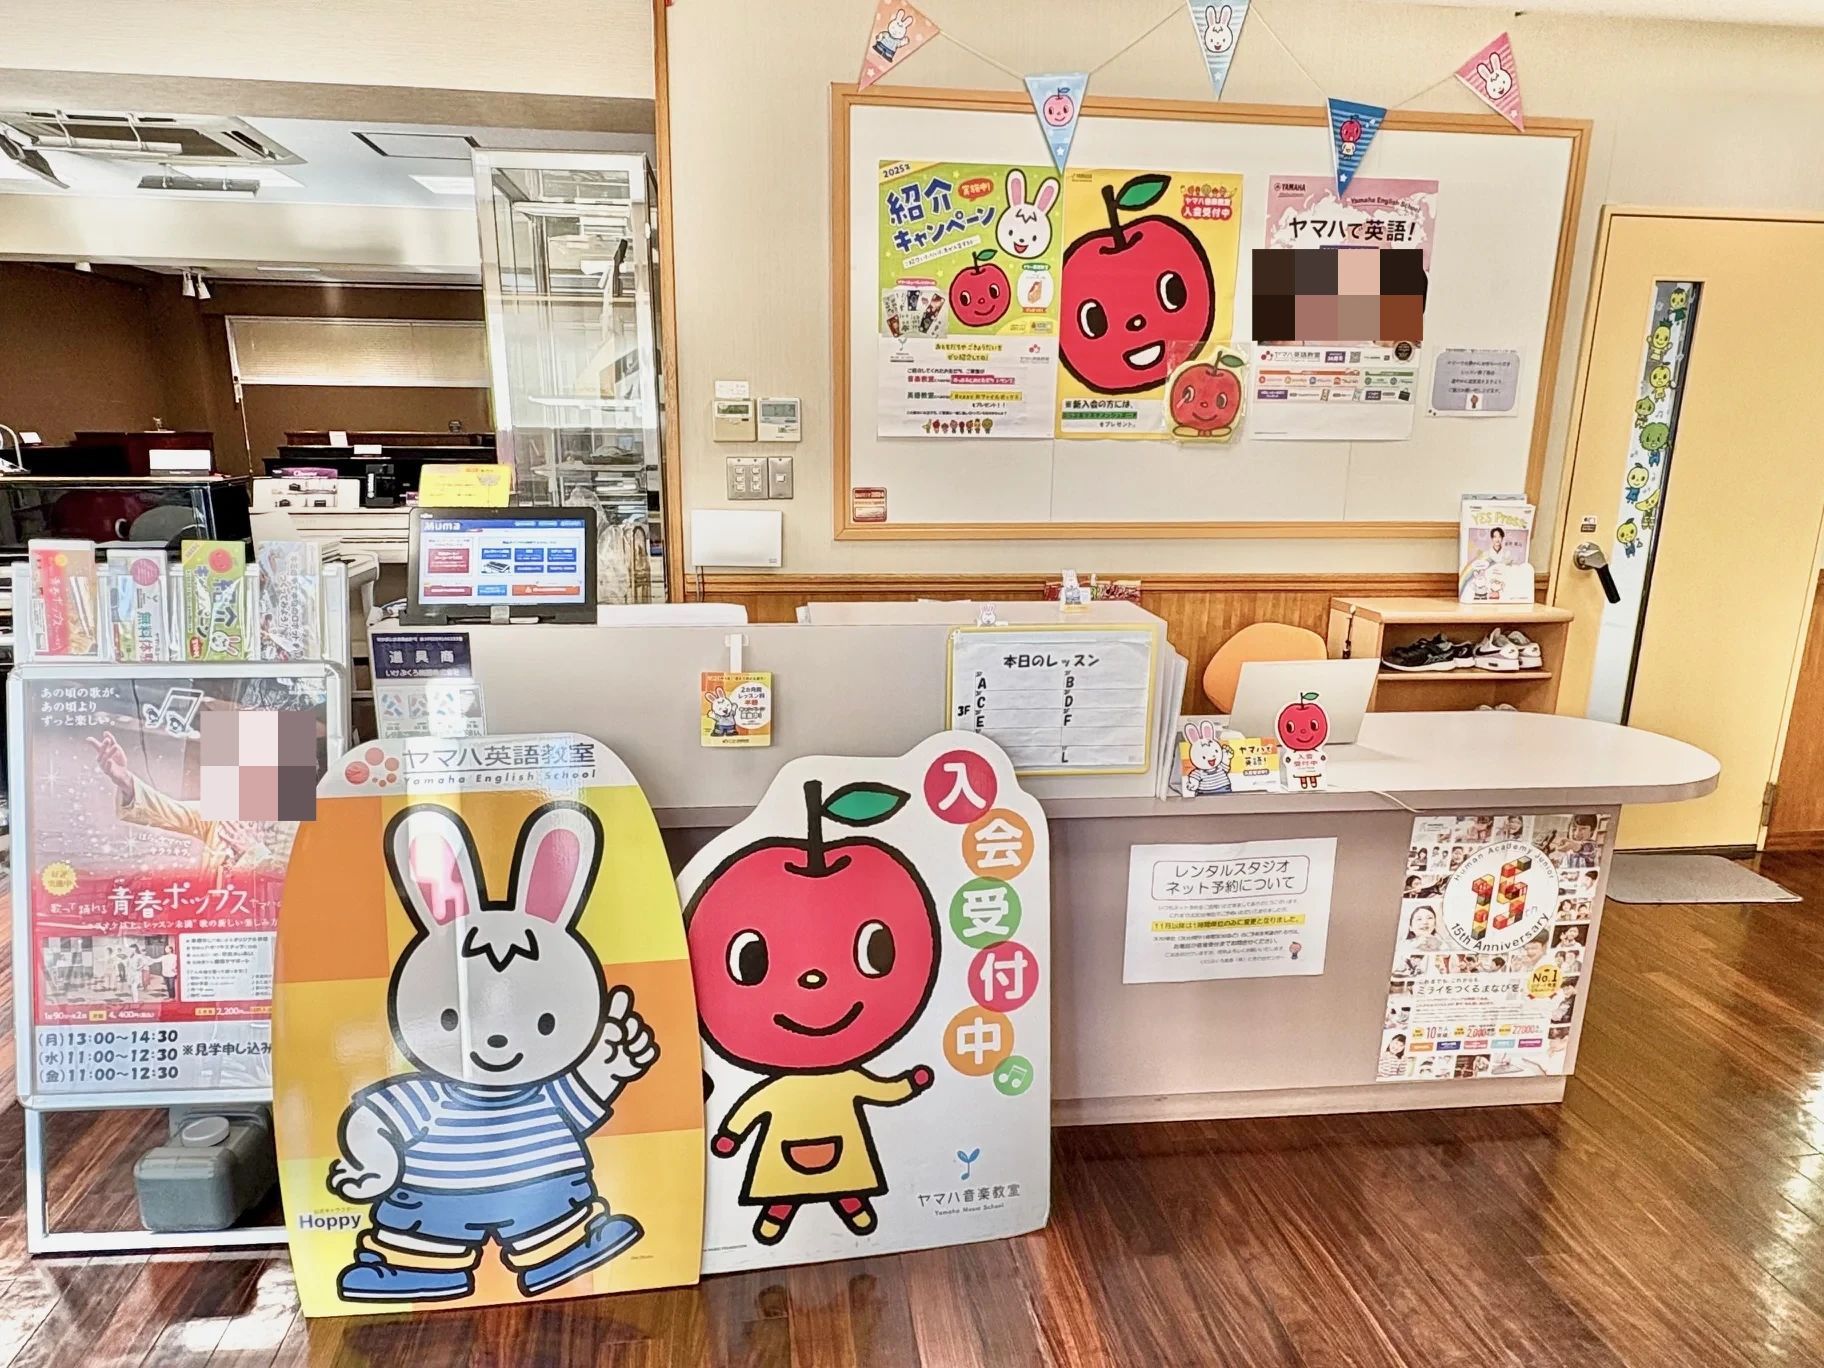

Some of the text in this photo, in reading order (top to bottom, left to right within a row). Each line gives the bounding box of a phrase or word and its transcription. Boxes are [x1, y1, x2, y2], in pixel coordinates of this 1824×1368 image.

[887, 178, 952, 224] 紹介
[1183, 206, 1231, 218] 入会受付中
[894, 207, 995, 252] キャンペーン
[1289, 217, 1416, 242] ヤマハで英語!
[424, 521, 461, 531] Muma
[1003, 654, 1100, 668] 本日のレッスン
[978, 677, 987, 690] A
[1065, 676, 1075, 689] B
[40, 687, 120, 699] あの頃の歌が、
[40, 702, 97, 713] あの頃より
[977, 696, 986, 709] C
[1064, 695, 1073, 707] D
[957, 705, 971, 717] 3F
[40, 715, 116, 727] ずっと楽しい。
[976, 715, 985, 728] E
[1063, 714, 1073, 727] F
[402, 743, 595, 769] ヤマハ英語教室
[1061, 751, 1069, 763] L
[404, 769, 596, 786] Yamaha English School
[1453, 843, 1555, 881] Human Academy Junior
[1175, 860, 1291, 879] レンタルスタジオ
[1166, 876, 1296, 896] ネット予約について
[108, 881, 251, 919] 青春ポップス
[938, 763, 1028, 1065] 入会受付中
[1451, 912, 1550, 952] 15th Anniversary
[1532, 969, 1557, 983] No.1
[1417, 984, 1524, 995] ミライをつくるまなびを。
[182, 1042, 273, 1056] ※見学申し込み
[918, 1184, 1020, 1207] ヤマハ音楽教室
[299, 1214, 362, 1230] Hoppy
